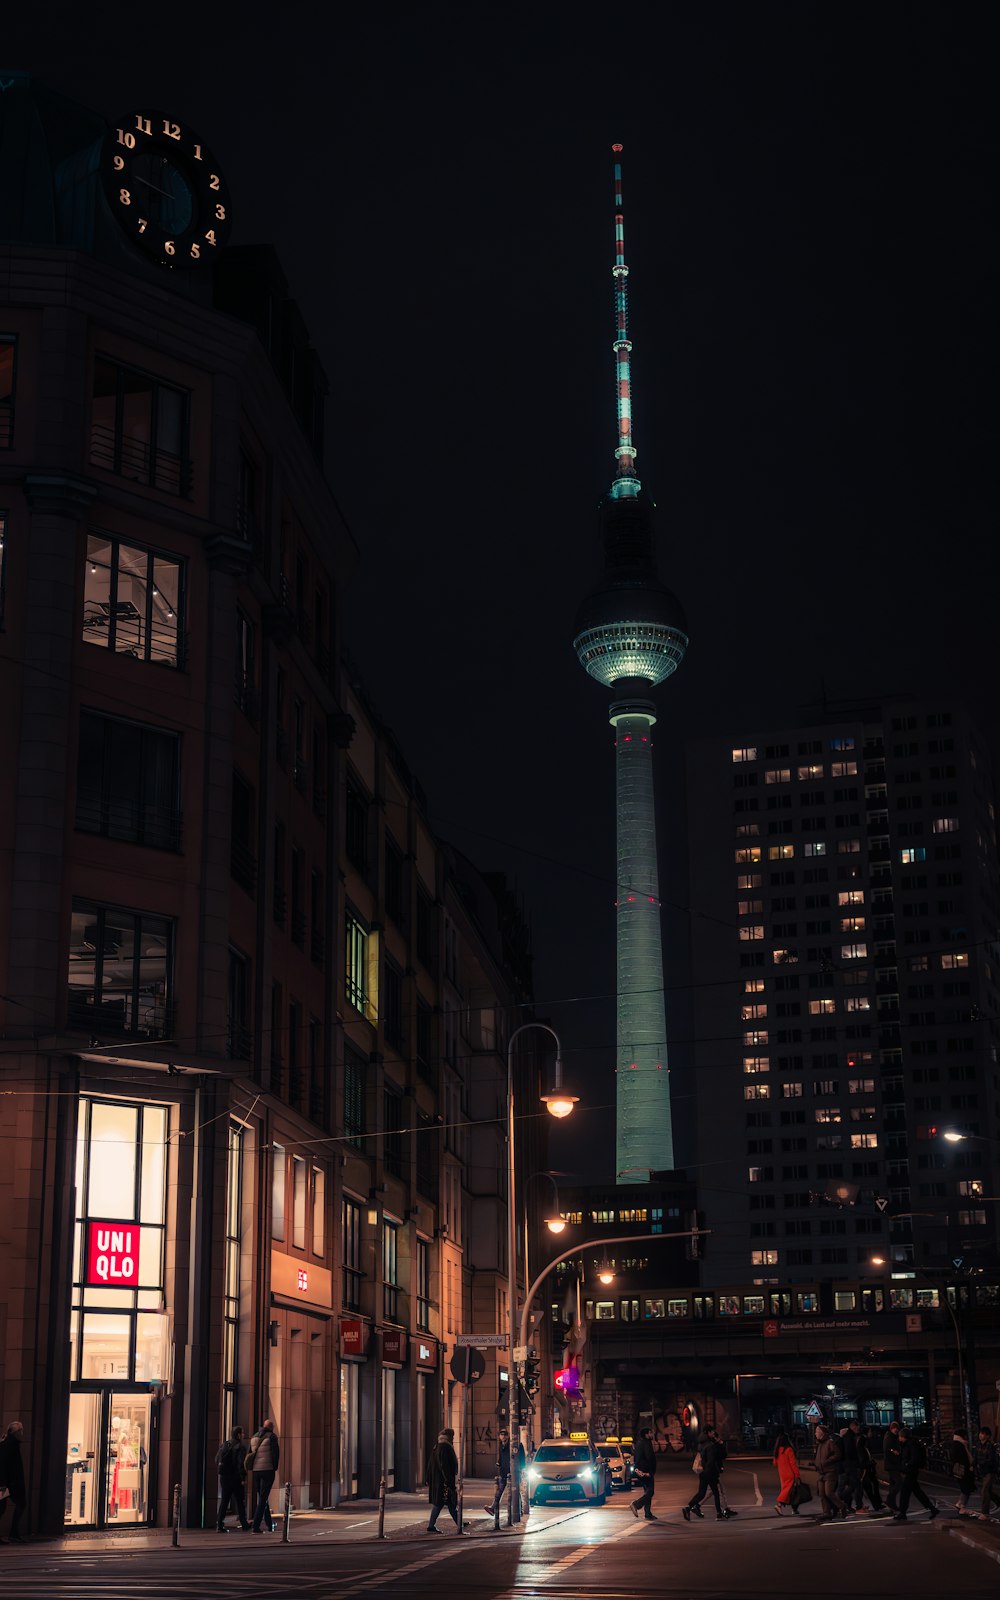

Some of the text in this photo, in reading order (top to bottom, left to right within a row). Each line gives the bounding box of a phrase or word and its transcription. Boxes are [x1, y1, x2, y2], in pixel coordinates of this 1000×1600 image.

[136, 115, 152, 135] 11
[162, 120, 180, 140] 12
[116, 129, 135, 149] 10
[193, 144, 203, 160] 1
[113, 156, 124, 171] 9
[209, 174, 219, 191] 2
[119, 189, 131, 206] 8
[215, 204, 225, 220] 3
[137, 218, 148, 234] 7
[205, 230, 217, 246] 4
[164, 241, 175, 255] 6
[190, 243, 201, 259] 5
[97, 1230, 132, 1253] UNI
[96, 1255, 134, 1280] QLO
